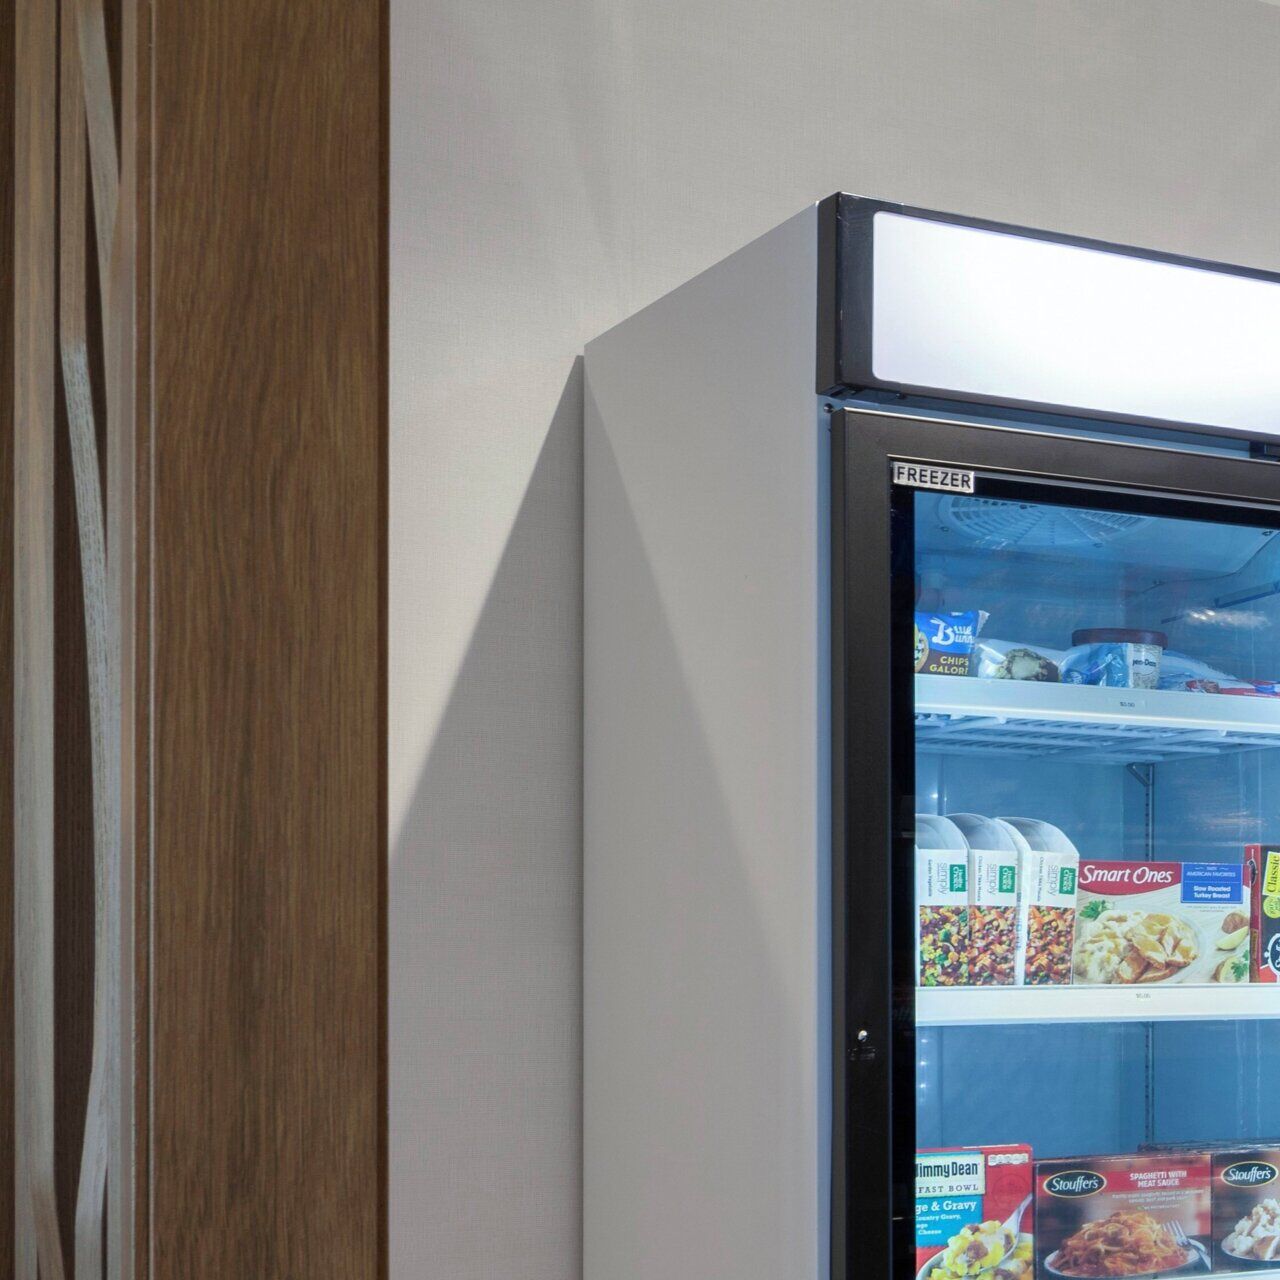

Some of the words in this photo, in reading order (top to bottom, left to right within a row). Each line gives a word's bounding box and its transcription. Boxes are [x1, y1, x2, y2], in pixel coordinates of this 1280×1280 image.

[897, 466, 971, 489] FREEZER
[940, 656, 969, 665] CHIPS
[1079, 865, 1134, 884] Smart
[1132, 866, 1173, 884] Ones
[1267, 856, 1279, 893] Classic
[951, 1161, 978, 1176] Dean
[1130, 1171, 1167, 1181] SPAGHETTI
[1168, 1170, 1188, 1178] WITH
[1228, 1166, 1272, 1183] Stouffer's
[917, 1184, 944, 1194] FAST
[949, 1184, 979, 1193] BOWL
[1051, 1176, 1099, 1193] Stouffer's
[1137, 1179, 1156, 1188] MEAT
[1157, 1178, 1180, 1187] SAUCE
[931, 1201, 941, 1212] &
[943, 1200, 977, 1212] Gravy
